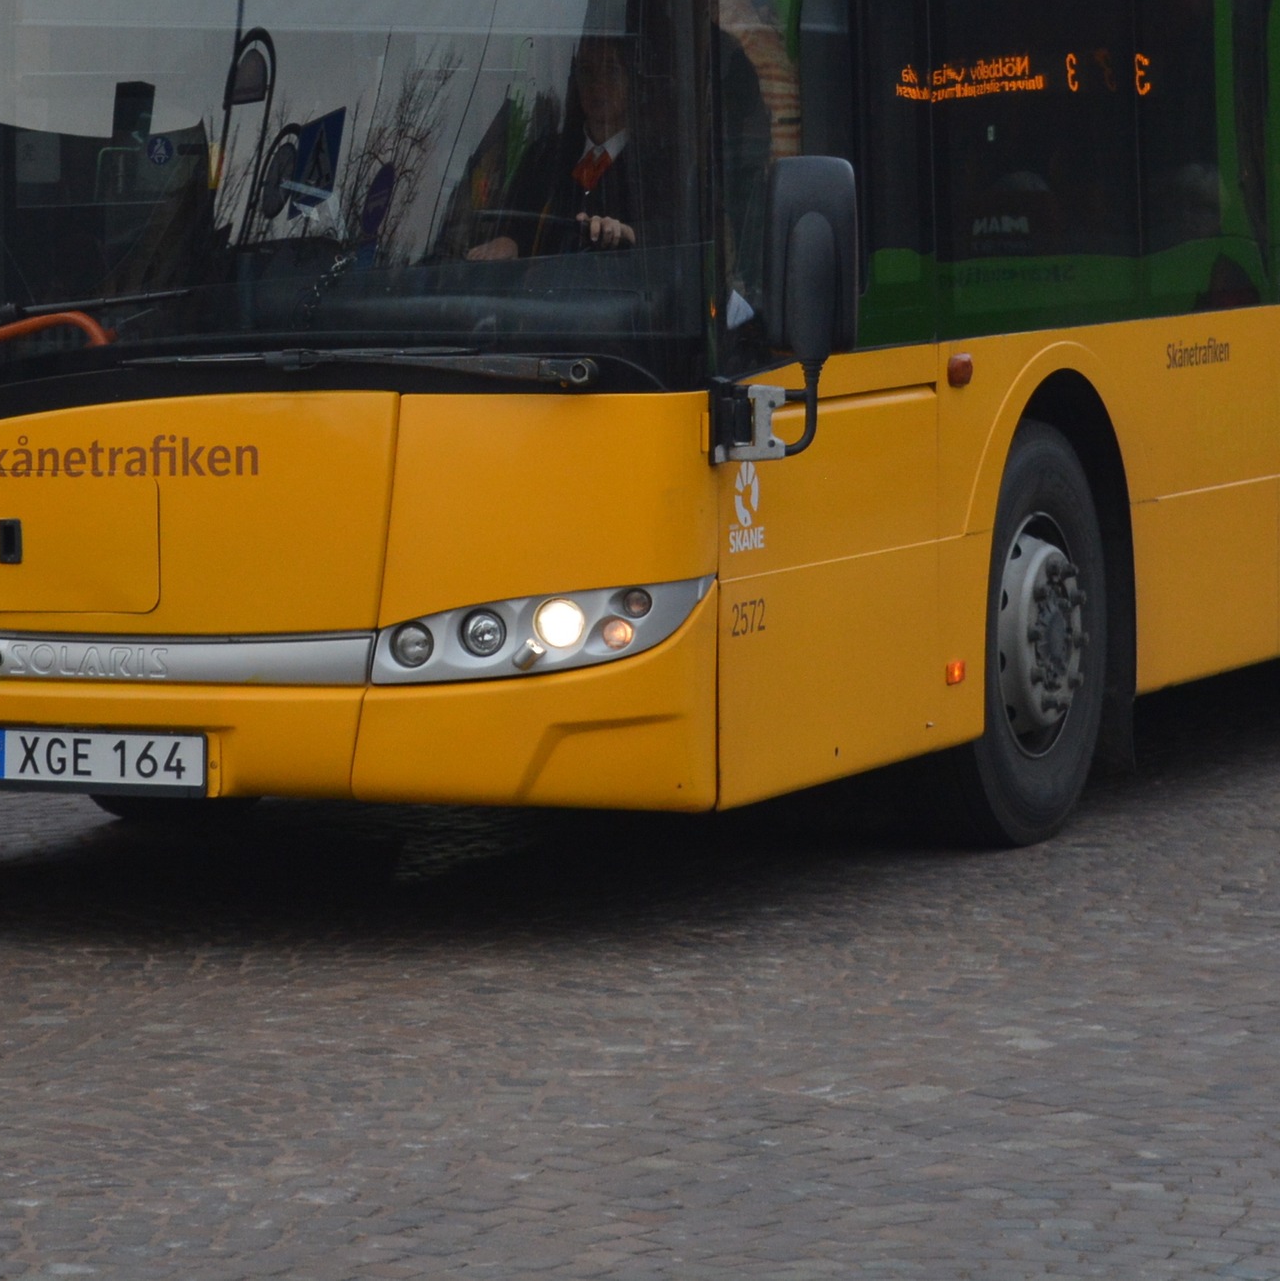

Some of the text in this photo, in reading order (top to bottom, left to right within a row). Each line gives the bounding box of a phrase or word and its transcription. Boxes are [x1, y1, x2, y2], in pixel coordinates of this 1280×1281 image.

[1166, 336, 1230, 369] Skånetrafiken
[732, 597, 766, 638] 2572
[10, 643, 169, 679] SOLARIS
[18, 735, 187, 780] XGE 164
